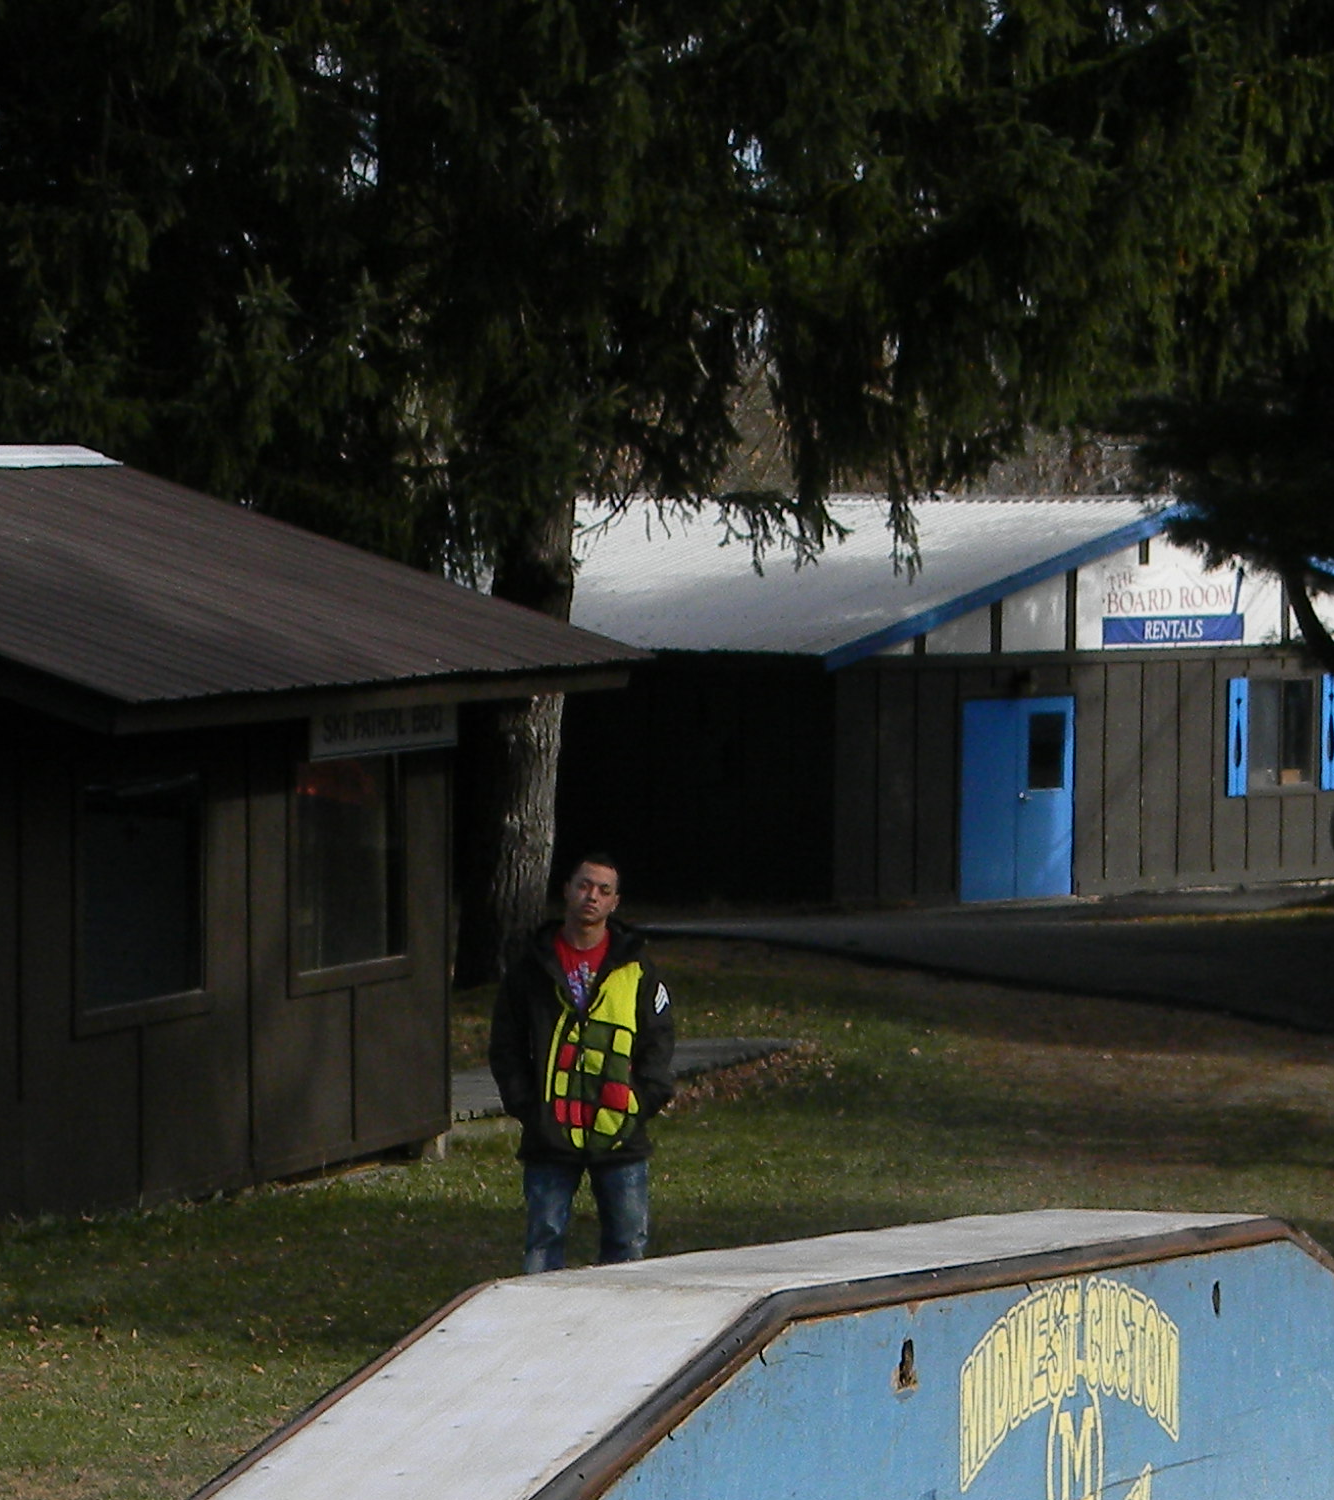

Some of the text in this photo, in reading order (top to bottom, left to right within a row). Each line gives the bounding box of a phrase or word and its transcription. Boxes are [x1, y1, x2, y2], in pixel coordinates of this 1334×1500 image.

[1107, 567, 1135, 592] THE
[1107, 584, 1233, 614] BOARD ROOM
[1144, 618, 1204, 641] RENTALS
[322, 713, 348, 744] SKI
[960, 1276, 1180, 1493] MIDWEST CUSTOM
